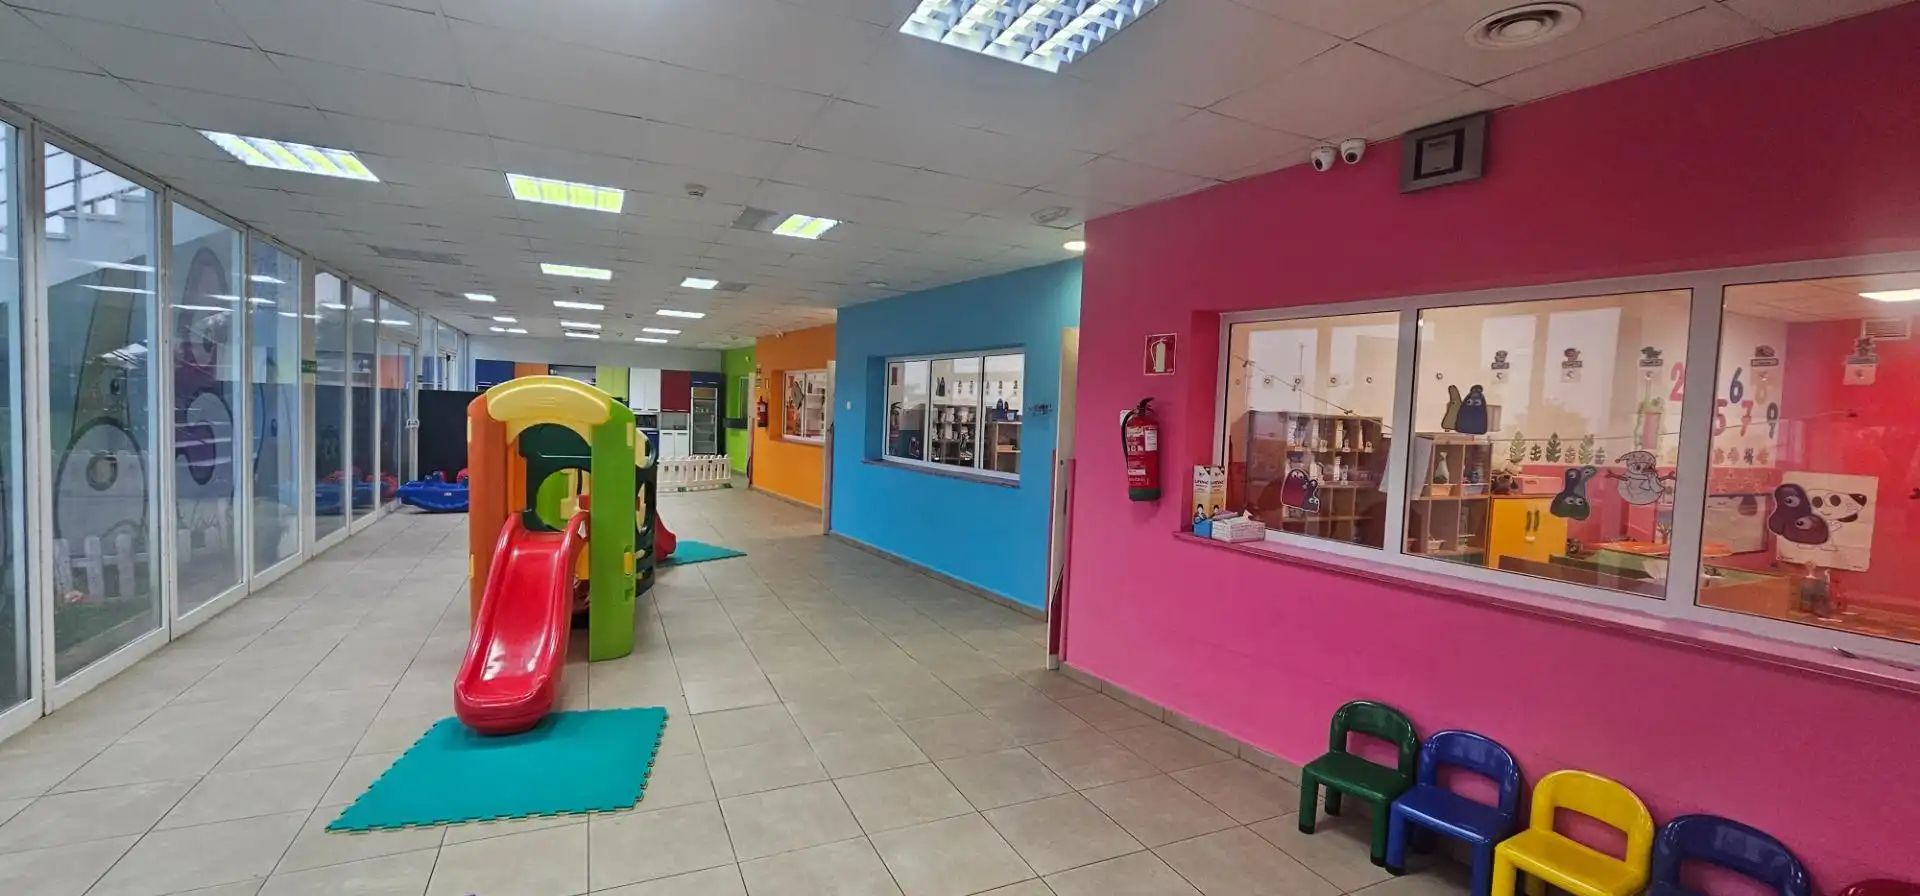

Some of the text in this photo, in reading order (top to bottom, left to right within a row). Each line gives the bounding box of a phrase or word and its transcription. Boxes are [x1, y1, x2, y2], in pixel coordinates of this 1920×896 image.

[1670, 362, 1684, 401] 2
[1714, 399, 1728, 436] 5
[1729, 367, 1743, 404] 6
[1741, 400, 1754, 437] 7
[1766, 402, 1779, 439] 9
